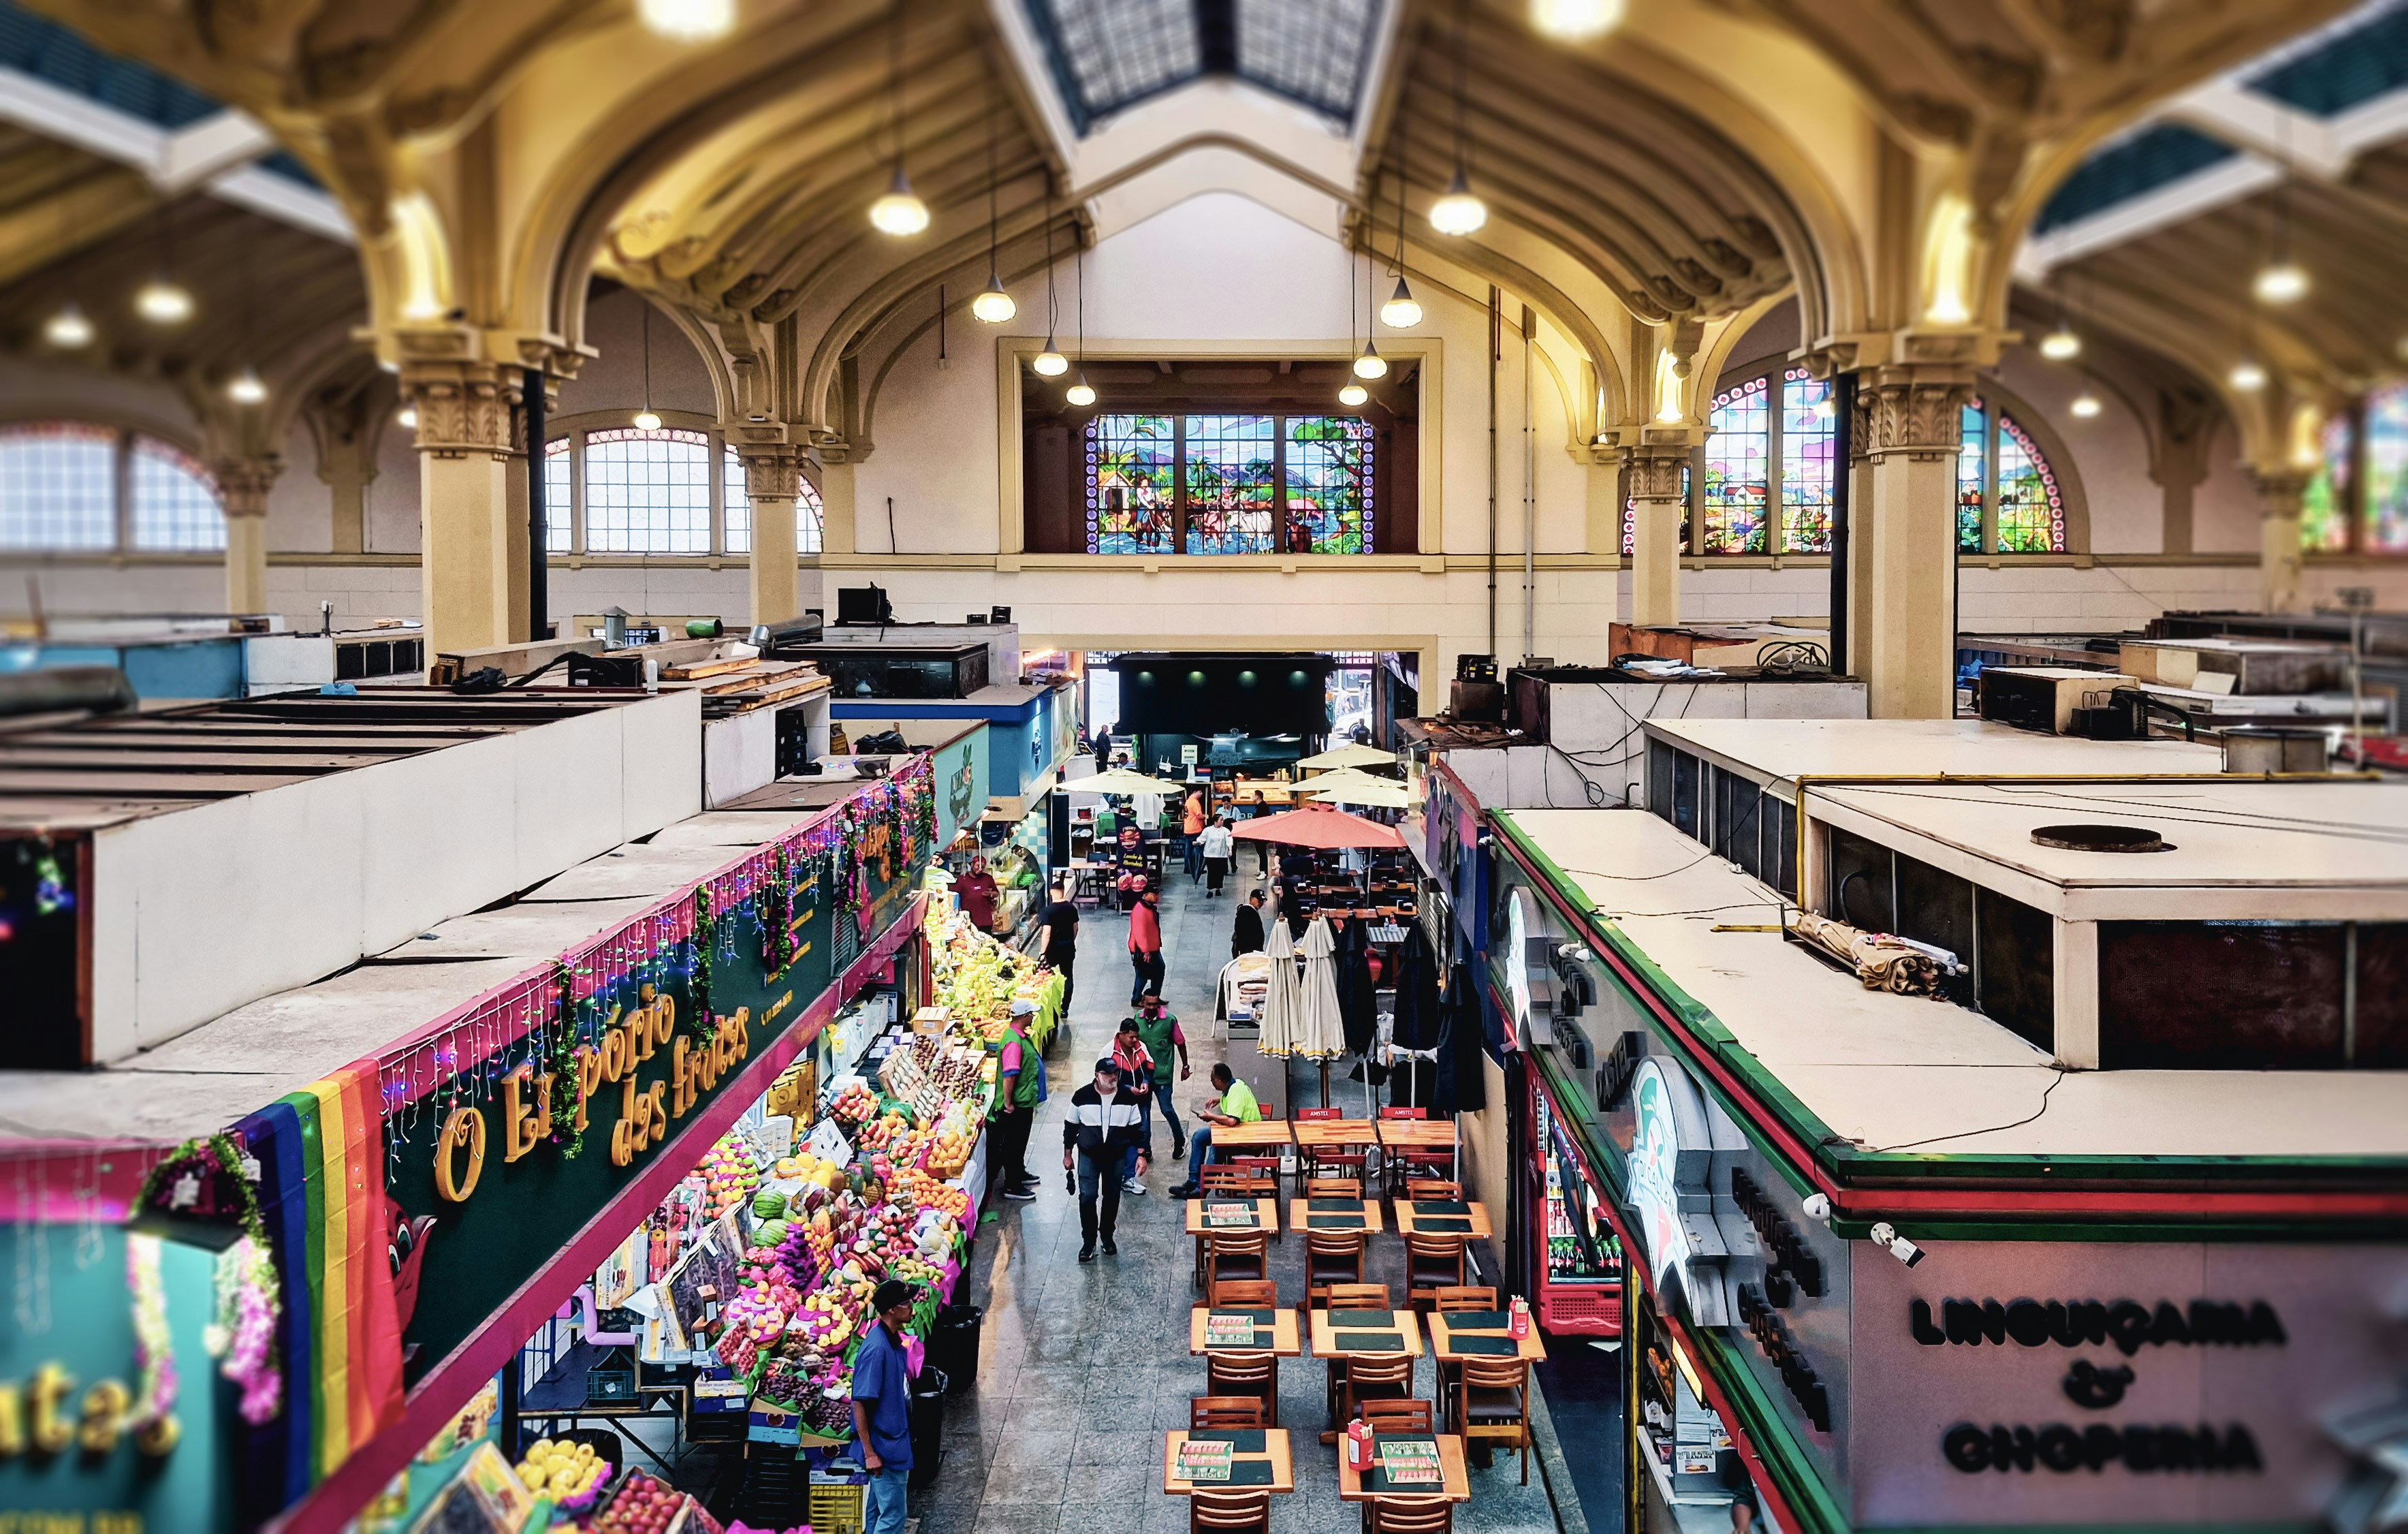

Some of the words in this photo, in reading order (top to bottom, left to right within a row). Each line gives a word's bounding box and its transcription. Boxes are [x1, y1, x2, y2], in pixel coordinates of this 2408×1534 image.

[612, 1073, 667, 1167] das
[671, 1006, 750, 1118] frutas
[435, 1106, 486, 1202] O
